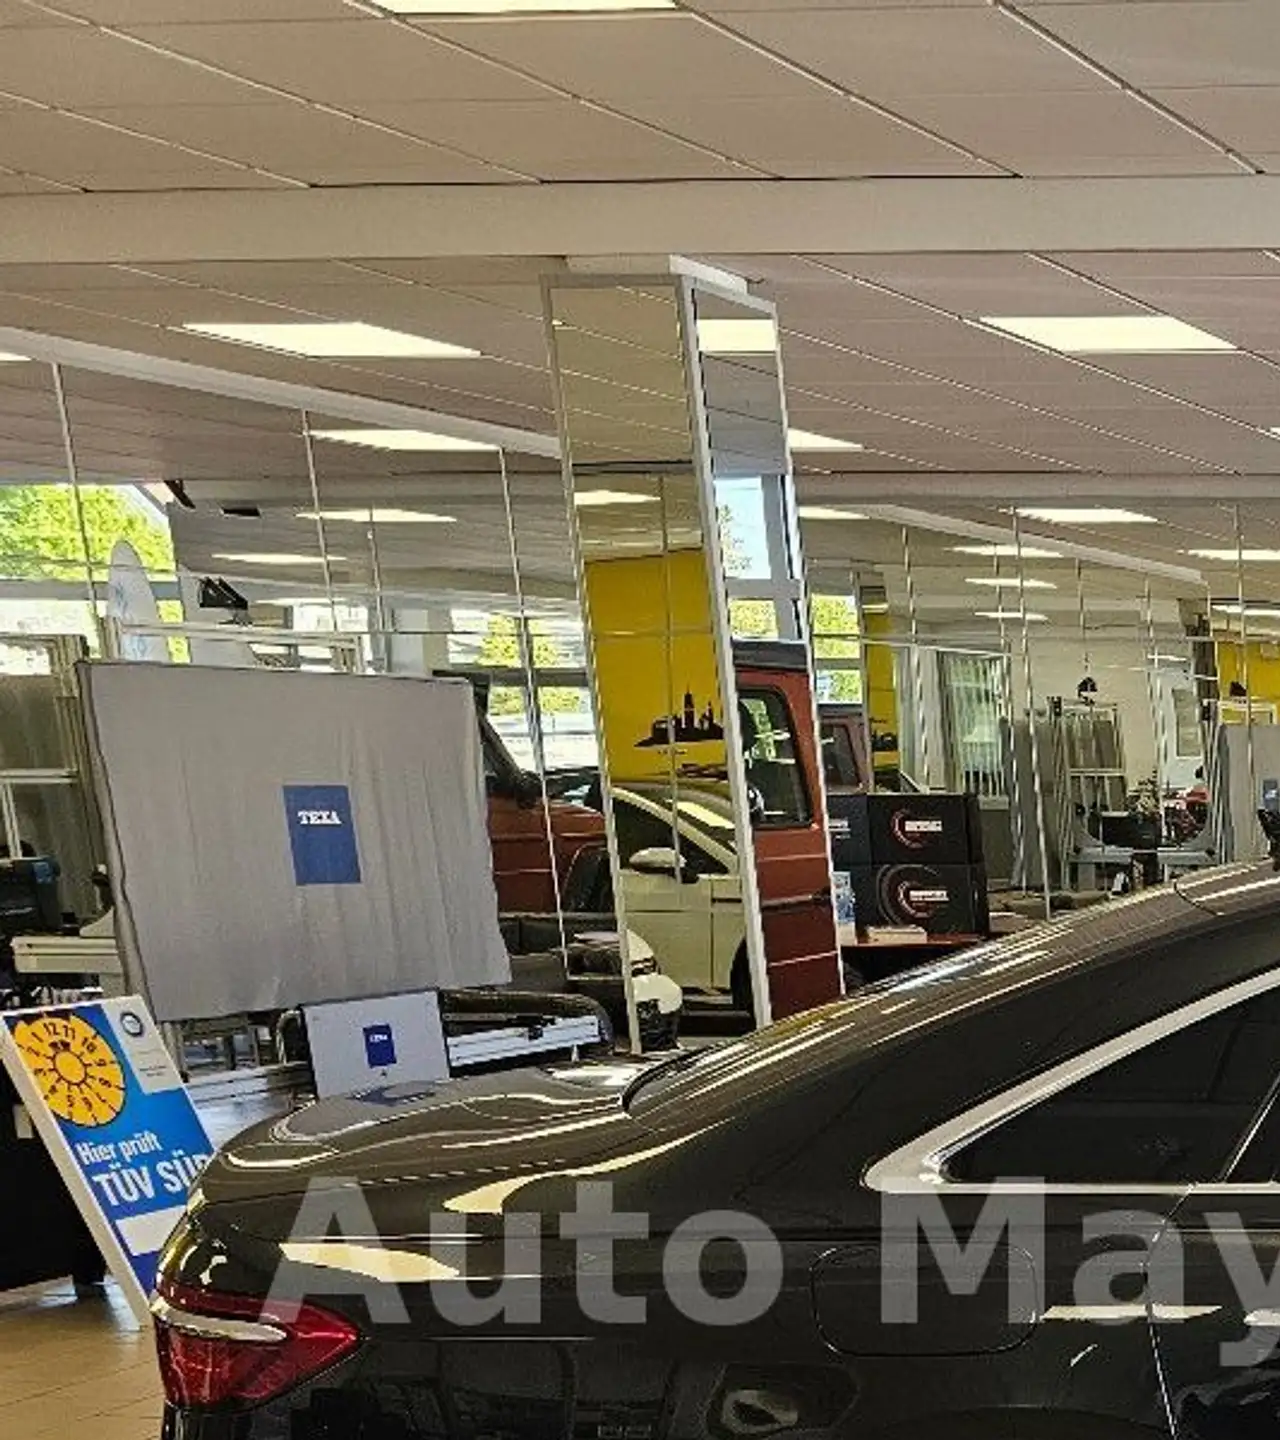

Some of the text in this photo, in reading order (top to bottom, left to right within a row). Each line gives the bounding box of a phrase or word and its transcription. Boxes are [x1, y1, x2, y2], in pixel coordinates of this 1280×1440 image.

[298, 811, 342, 825] TEXA
[74, 1129, 163, 1166] Hier prüft
[92, 1161, 156, 1206] TÜV
